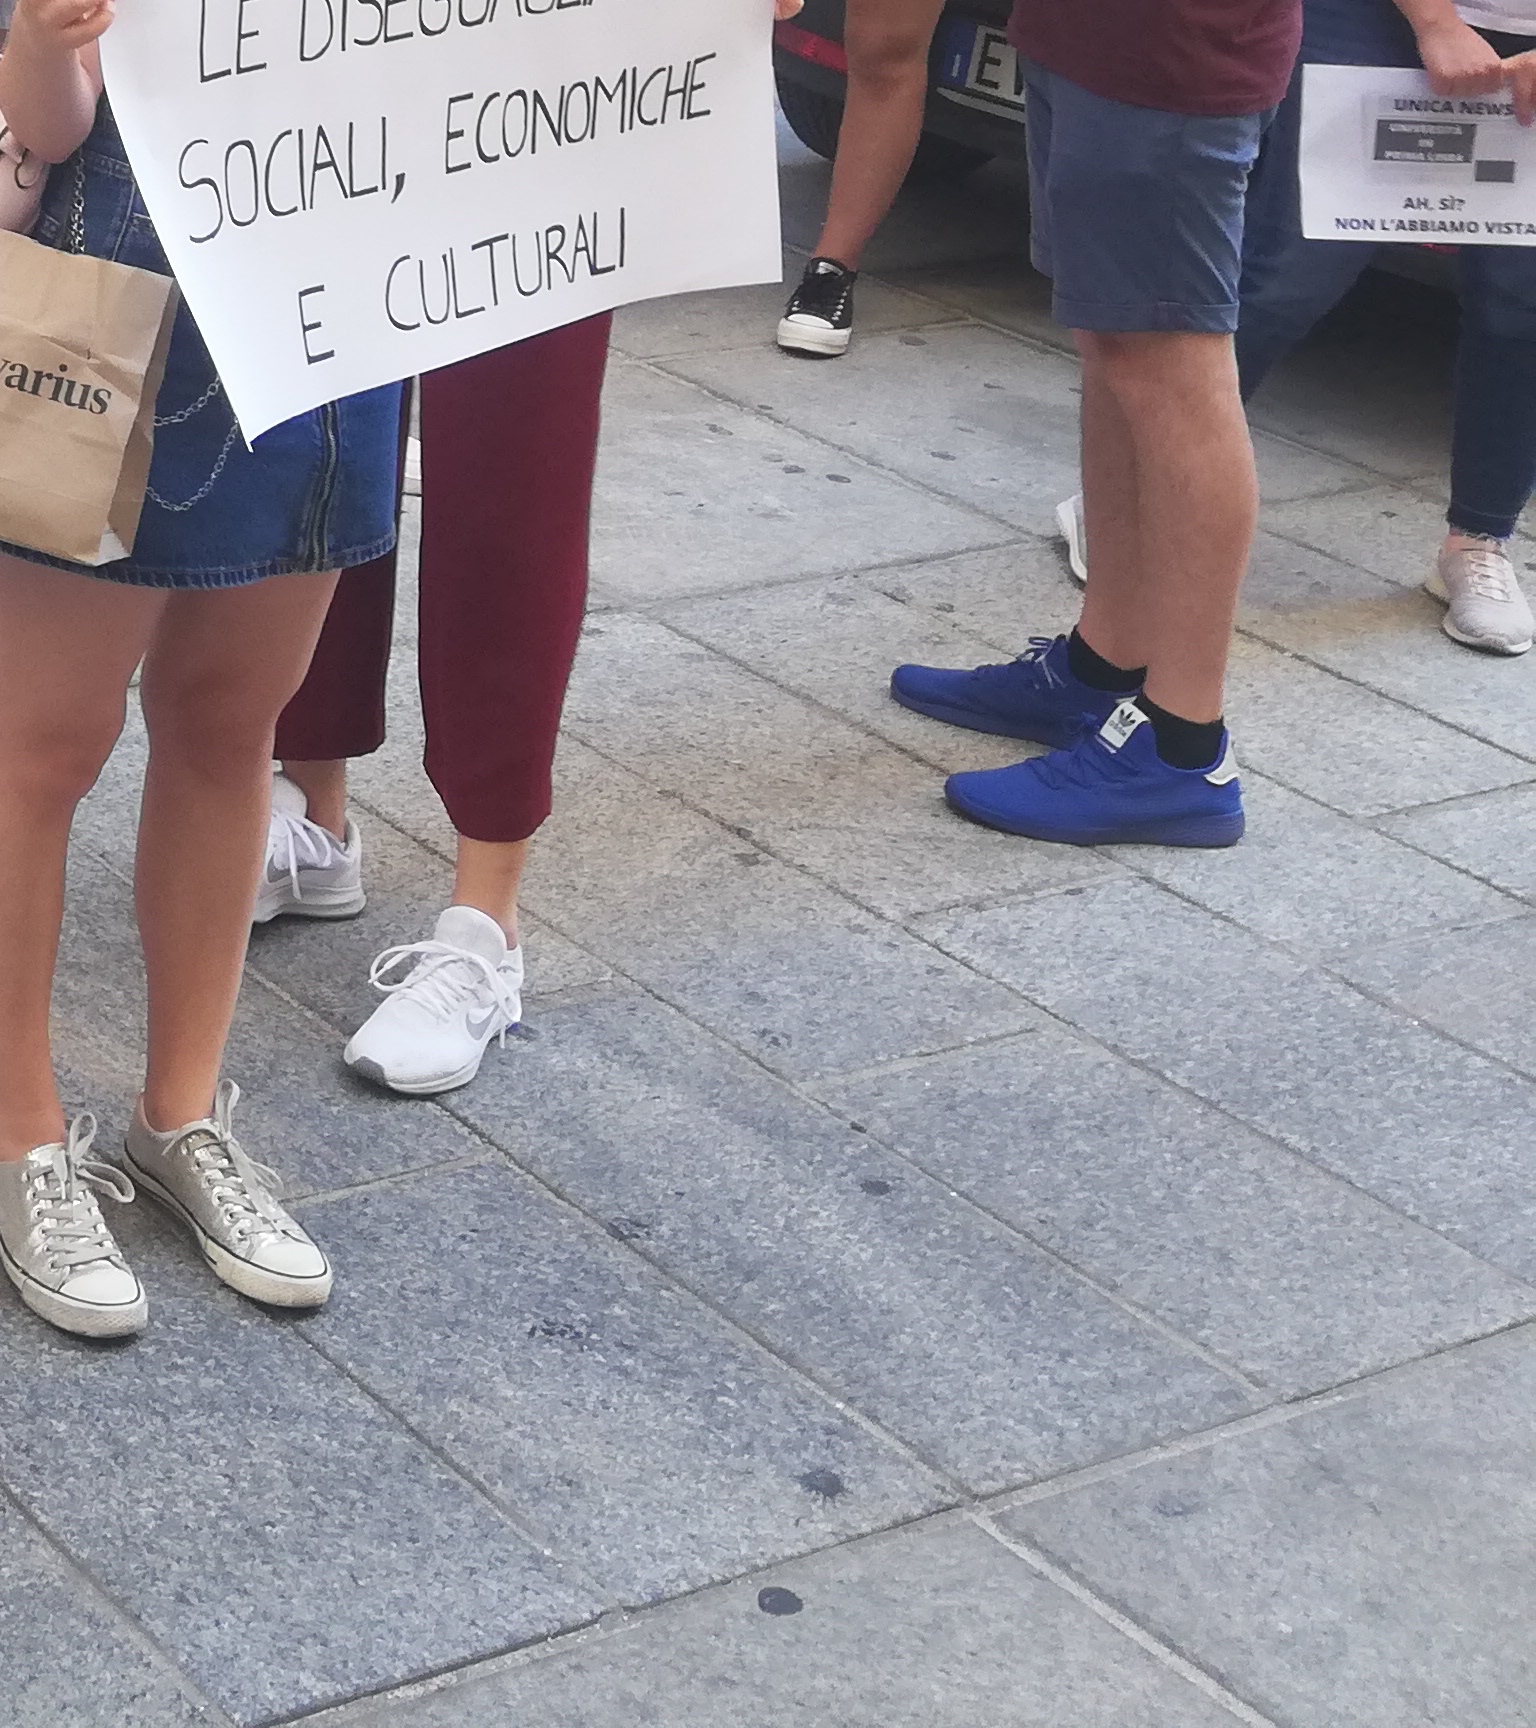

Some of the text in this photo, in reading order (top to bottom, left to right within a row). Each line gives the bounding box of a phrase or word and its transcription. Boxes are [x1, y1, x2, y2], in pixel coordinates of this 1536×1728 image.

[178, 52, 717, 244] SOCIALI, ECONOMICHE
[1393, 98, 1515, 116] UNICA NEWS
[1334, 217, 1377, 232] NON
[1379, 218, 1480, 234] L'ABBIAMO
[296, 206, 627, 366] E CULTURALI
